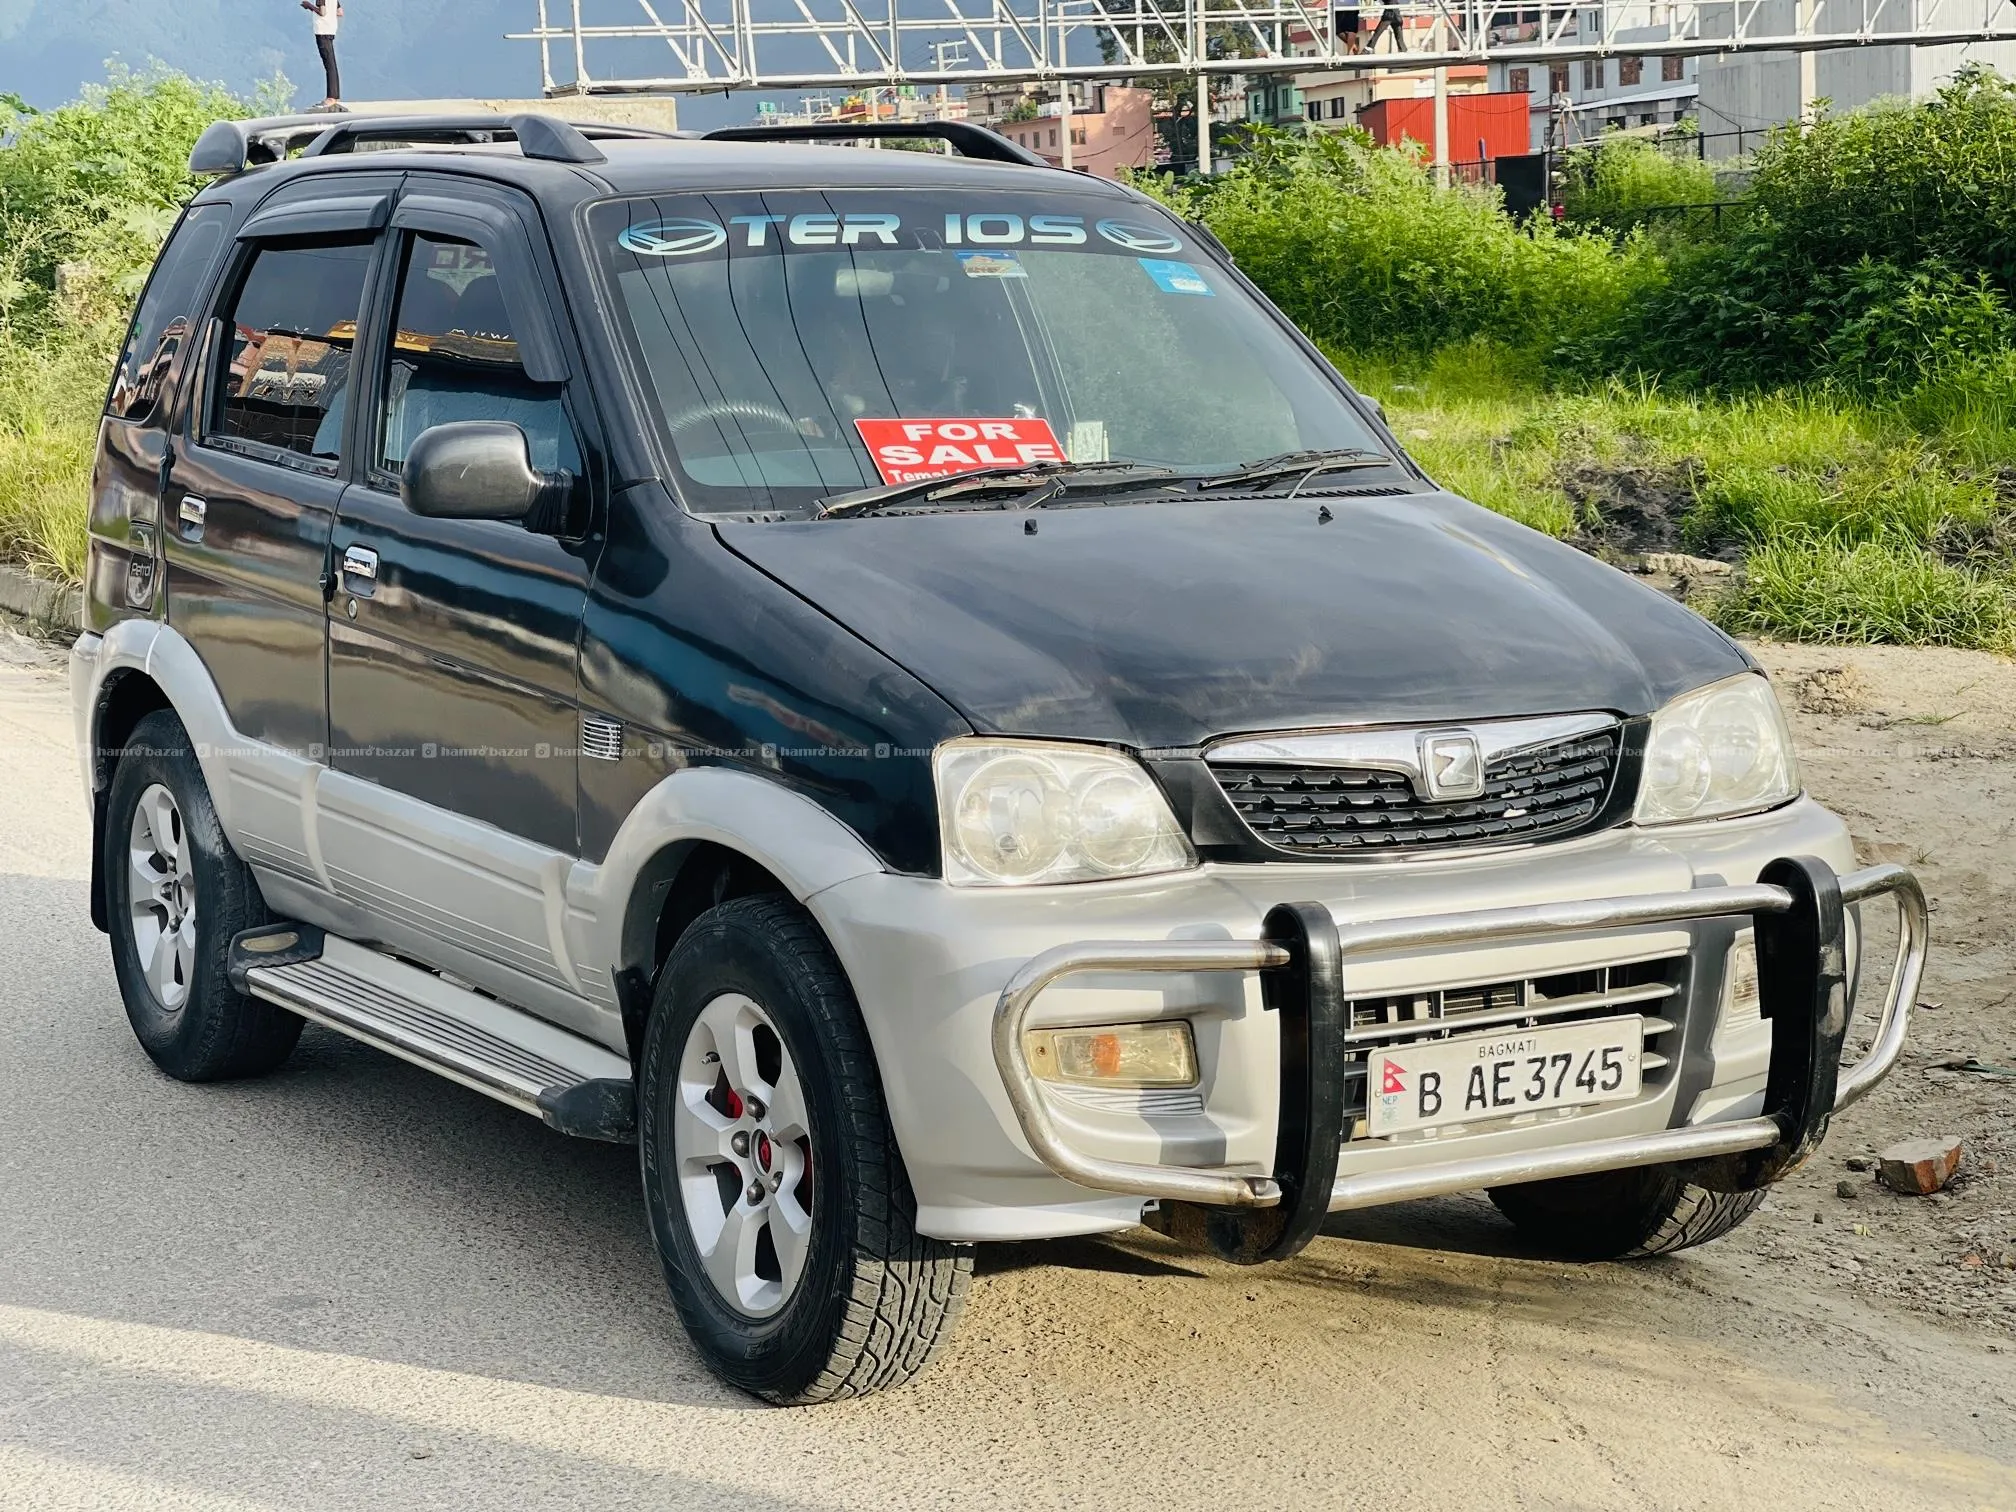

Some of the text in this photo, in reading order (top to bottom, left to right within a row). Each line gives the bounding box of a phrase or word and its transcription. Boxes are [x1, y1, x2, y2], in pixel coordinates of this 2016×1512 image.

[729, 213, 901, 247] TER
[902, 422, 1022, 442] FOR
[878, 444, 1060, 466] SALE
[1479, 1039, 1537, 1058] BAGMATI
[1382, 1095, 1399, 1105] NEP
[1419, 1071, 1442, 1118] B
